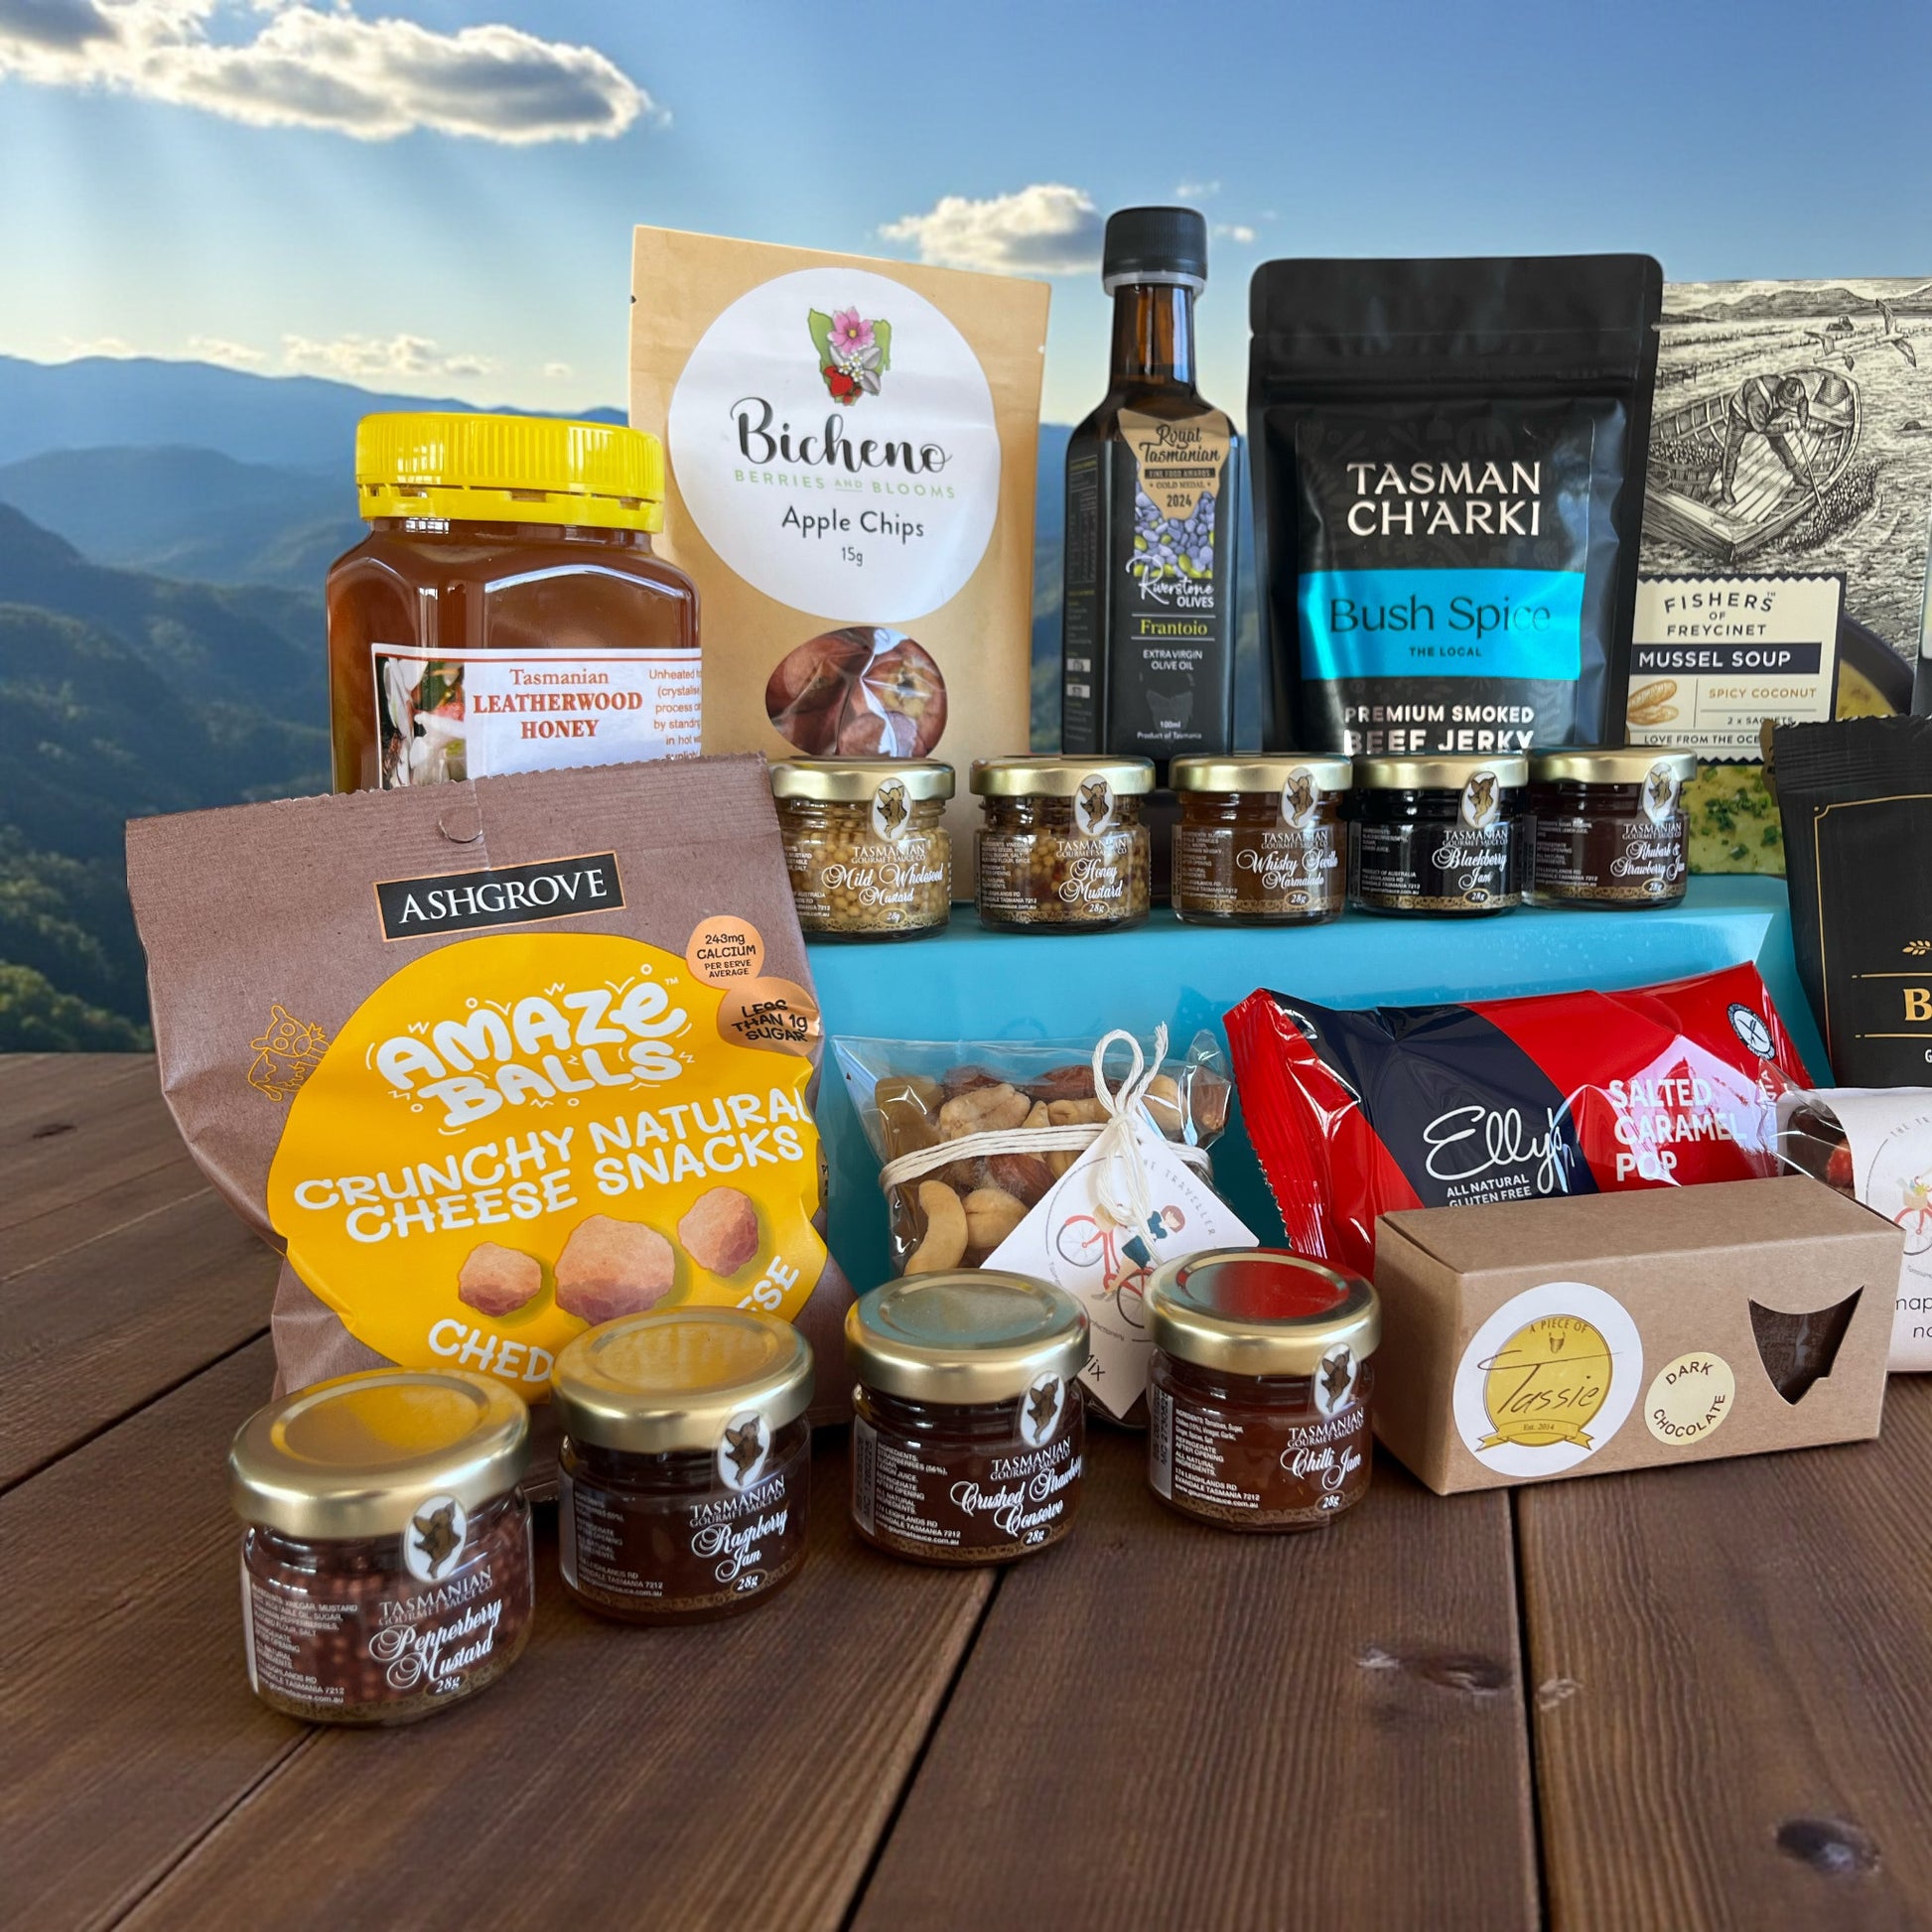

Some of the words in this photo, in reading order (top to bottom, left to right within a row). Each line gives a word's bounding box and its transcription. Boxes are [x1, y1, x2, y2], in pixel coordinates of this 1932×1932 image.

[730, 397, 952, 474] Bicheno
[1156, 424, 1202, 450] Royal
[1139, 443, 1220, 463] Tasmanian
[735, 470, 824, 488] BERRIES
[835, 480, 863, 489] AND
[873, 482, 954, 498] BLOOMS
[1346, 462, 1541, 494] TASMAN
[1168, 494, 1191, 507] 2024
[781, 506, 850, 541] Apple
[860, 511, 924, 544] Chips
[1347, 500, 1540, 536] CH'ARKI
[841, 547, 863, 566] 15g
[1126, 554, 1214, 605] Riverstone
[1176, 597, 1214, 608] OLIVES
[1664, 593, 1772, 613] FISHERS
[1329, 595, 1434, 632] Bush
[1449, 596, 1550, 639] Spice
[1710, 612, 1725, 621] OF
[1141, 620, 1207, 635] Frantoio
[1667, 624, 1766, 636] FREYCINET
[1143, 649, 1171, 659] EXTRA
[1172, 650, 1202, 659] VIRGIN
[1409, 647, 1435, 657] THE
[1441, 647, 1482, 657] LOCAL
[1638, 651, 1724, 667] MUSSEL
[1731, 651, 1791, 667] SOUP
[649, 669, 694, 679] Unheated
[1152, 661, 1176, 670] OLIVE
[1178, 661, 1193, 671] OIL
[510, 668, 609, 686] Tasmanian
[473, 692, 642, 714] LEATHERWOOD
[1710, 688, 1746, 699] SPICY
[1751, 688, 1816, 698] COCONUT
[656, 704, 692, 714] process
[1345, 705, 1445, 723] PREMIUM
[1452, 705, 1535, 723] SMOKED
[520, 720, 599, 739] HONEY
[654, 720, 665, 731] by
[1746, 716, 1793, 725] SACETS
[666, 736, 674, 745] in
[678, 735, 691, 745] hot
[1345, 730, 1427, 755] BEEF
[1439, 729, 1535, 755] JERKY
[1713, 735, 1732, 744] THE
[1737, 735, 1759, 744] OCE
[1444, 829, 1508, 841] TASMANIAN
[1623, 822, 1681, 833] TASMANIAN
[1056, 840, 1127, 852] TASMANIAN
[1261, 832, 1327, 843] TASMANIAN
[852, 845, 925, 857] TASMANIAN
[1432, 845, 1507, 872] Blackberry
[1626, 840, 1672, 860] Rhubarb
[1672, 844, 1681, 856] &
[1070, 857, 1117, 884] Honey
[1236, 849, 1299, 877] Whisky
[1610, 856, 1666, 879] Strawberry
[821, 864, 874, 890] Mild
[1262, 870, 1324, 890] Marmalade
[1458, 866, 1492, 891] Jam
[398, 869, 608, 925] ASHGROVE
[859, 887, 914, 905] Mustard
[1058, 879, 1123, 902] Mustard
[1291, 894, 1307, 904] 28g
[1471, 892, 1485, 901] 28g
[1088, 902, 1105, 913] 28g
[887, 912, 900, 923] 28g
[705, 934, 745, 944] 243mg
[697, 945, 757, 959] CALCIUM
[709, 968, 750, 978] AVERAGE
[724, 959, 752, 968] SERVE
[742, 1000, 788, 1018] LESS
[732, 1014, 782, 1033] THAN
[789, 1014, 808, 1033] 1g
[746, 1030, 807, 1041] SUGAR
[416, 1040, 683, 1129] BALLS
[1609, 1078, 1713, 1108] SALTED
[1614, 1113, 1747, 1145] CARAMEL
[293, 1126, 575, 1210] CRUNCHY
[1616, 1151, 1678, 1181] POP
[345, 1169, 579, 1244] CHEESE
[594, 1125, 804, 1196] SNACKS
[1447, 1185, 1469, 1197] ALL
[1470, 1173, 1530, 1191] NATURAL
[1166, 1170, 1215, 1235] TRAVELLER
[1449, 1191, 1499, 1207] GLUTEN
[1501, 1186, 1532, 1201] FREE
[1529, 1323, 1536, 1334] A
[1540, 1317, 1570, 1331] PIECE
[1573, 1320, 1589, 1334] OF
[427, 1317, 555, 1383] CHED
[1477, 1350, 1621, 1414] Tassie
[1665, 1360, 1714, 1385] DARK
[1289, 1407, 1364, 1440] TASMANIAN
[1653, 1394, 1725, 1438] CHOCOLATE
[1175, 1435, 1216, 1454] REFRIGERATE
[1288, 1436, 1332, 1449] GOURMET
[992, 1437, 1071, 1472] TASMANIAN
[1194, 1449, 1224, 1463] OPENING
[990, 1464, 1038, 1481] GOURMET
[1281, 1447, 1334, 1480] Chilli
[1321, 1446, 1362, 1491] Jam
[1185, 1471, 1225, 1488] LEIGHLANDS
[689, 1474, 785, 1518] TASMANIAN
[895, 1487, 924, 1501] OPENING
[950, 1481, 1026, 1517] Crushed
[1206, 1487, 1242, 1500] TASMANIA
[1322, 1494, 1340, 1508] 28g
[689, 1507, 744, 1529] GOURMET
[994, 1499, 1064, 1538] Conserve
[691, 1509, 788, 1558] Raspberry
[906, 1522, 942, 1536] TASMANIA
[1025, 1530, 1045, 1545] 28g
[715, 1549, 762, 1584] Jam
[379, 1565, 491, 1617] TASMANIAN
[738, 1576, 759, 1590] 28g
[378, 1604, 440, 1627] GOURMET
[369, 1598, 502, 1662] Pepperberry
[386, 1630, 494, 1690] Mustard
[435, 1674, 461, 1694] 28g
